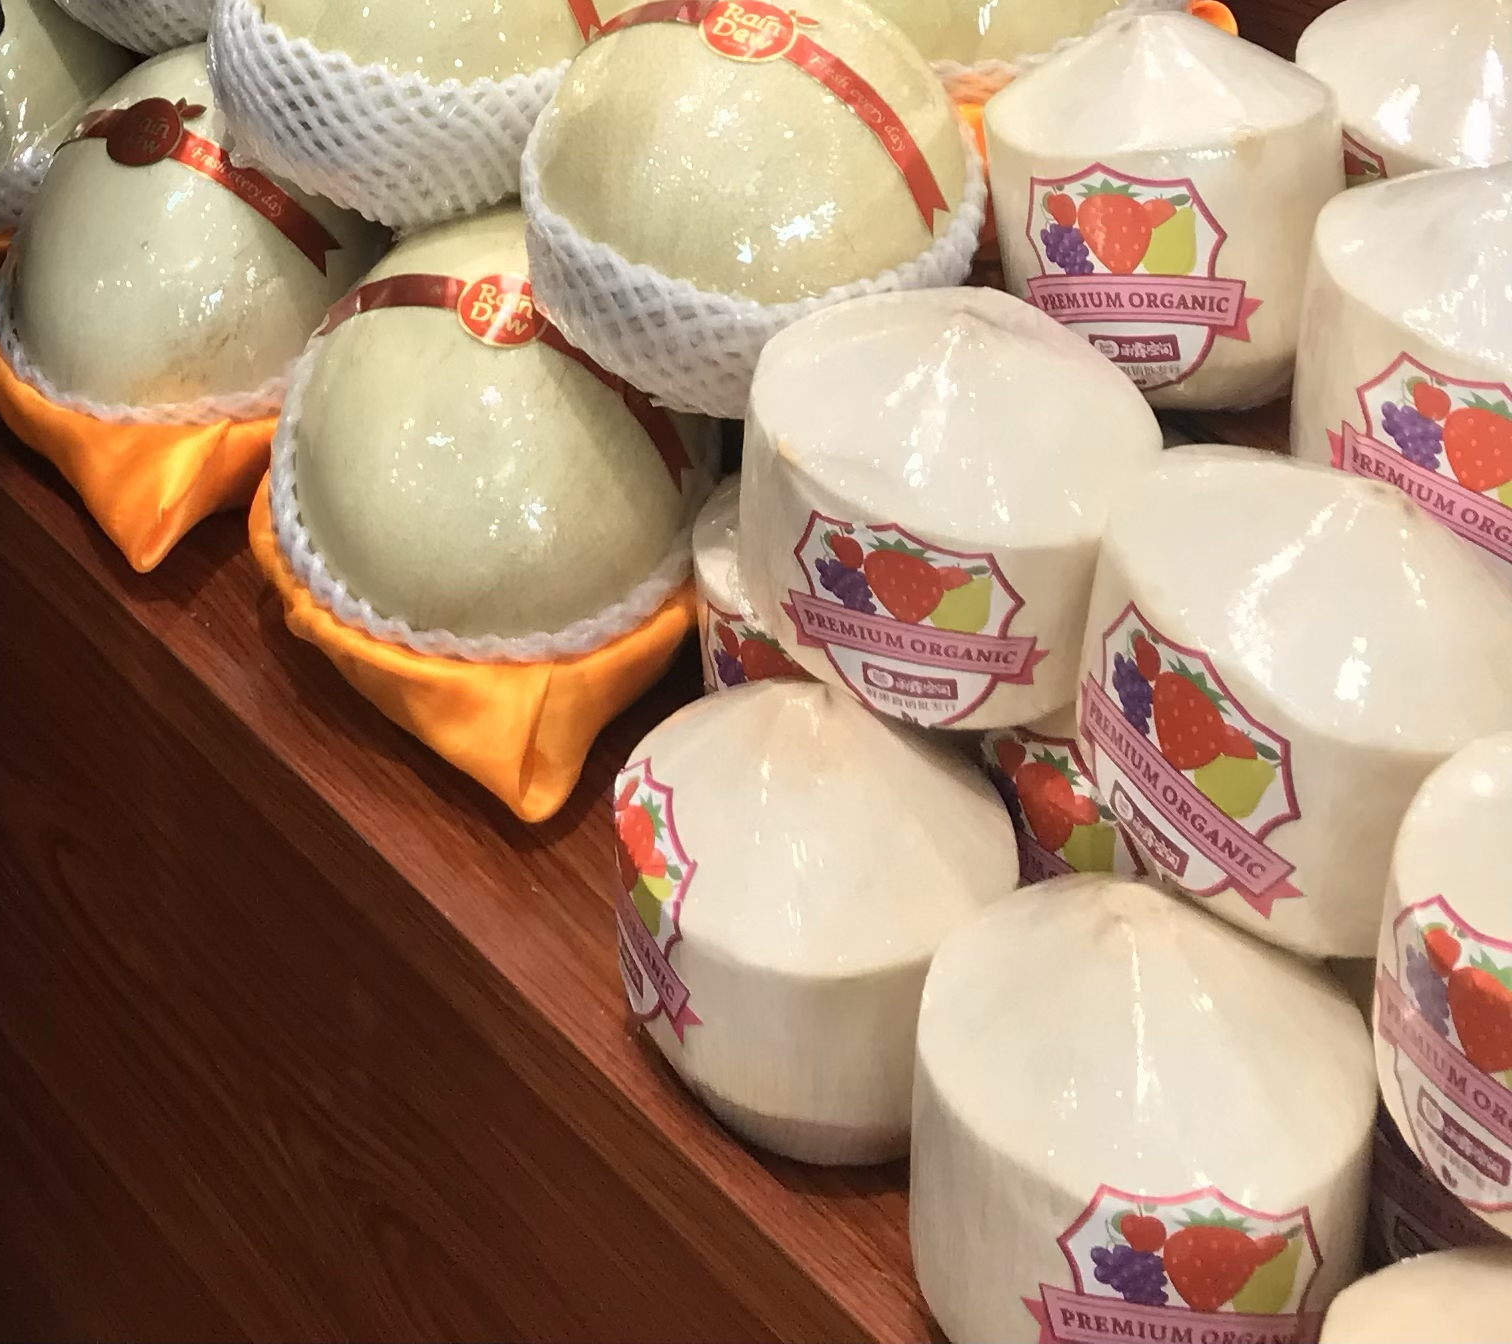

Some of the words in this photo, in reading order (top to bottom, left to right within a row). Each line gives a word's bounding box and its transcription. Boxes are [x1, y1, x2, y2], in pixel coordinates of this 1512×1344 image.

[711, 16, 773, 50] Dew
[724, 2, 783, 37] Rain
[808, 50, 854, 89] Fresh
[850, 88, 886, 125] every
[884, 124, 907, 152] day
[260, 192, 287, 218] day
[1039, 291, 1125, 312] PREMIUM
[1128, 292, 1231, 314] ORGANIC
[803, 608, 905, 650] PREMIUM
[909, 638, 1019, 666] ORGANIC
[1162, 784, 1267, 880] ORGANIC
